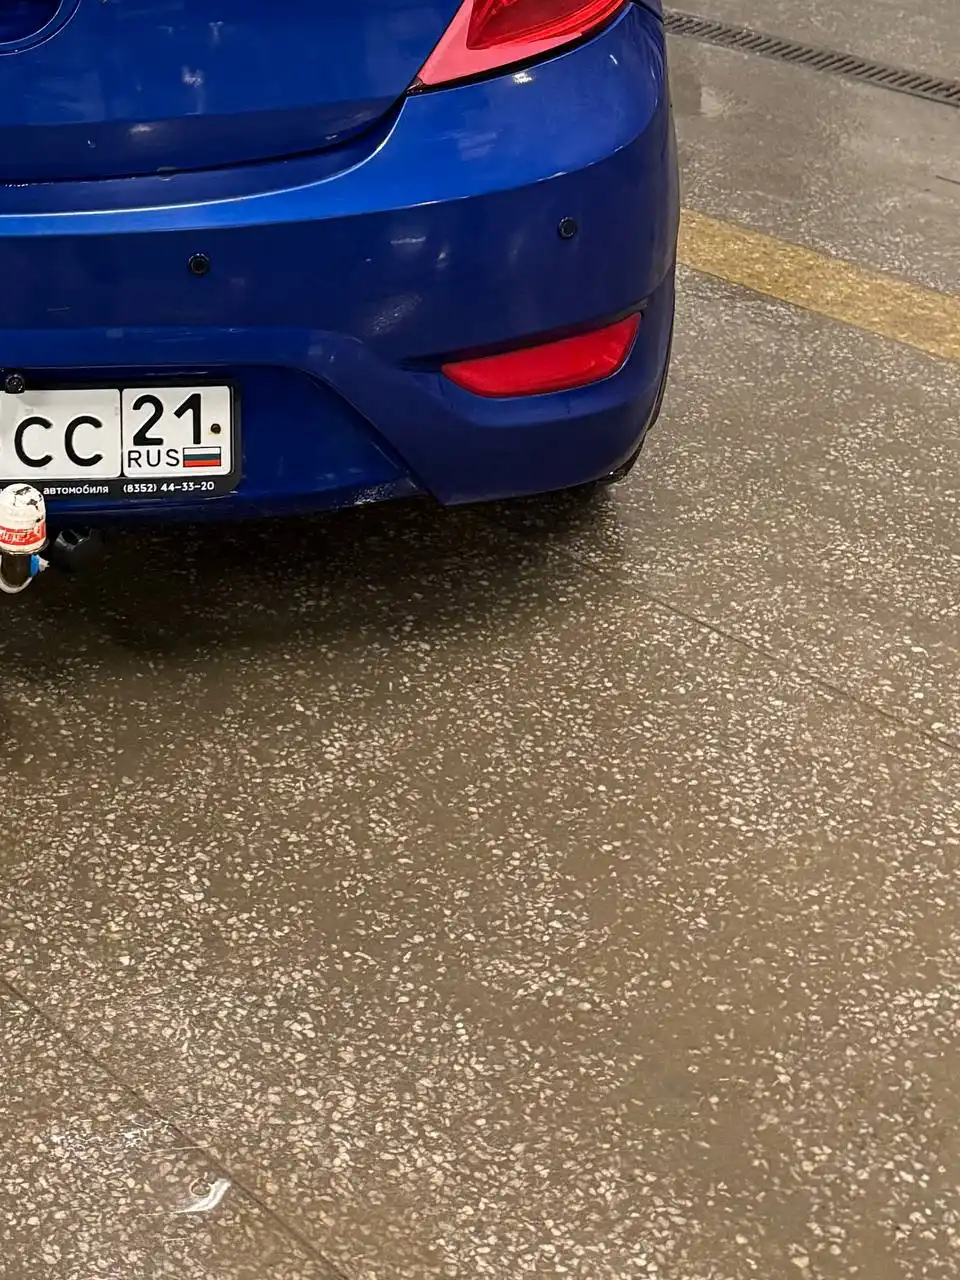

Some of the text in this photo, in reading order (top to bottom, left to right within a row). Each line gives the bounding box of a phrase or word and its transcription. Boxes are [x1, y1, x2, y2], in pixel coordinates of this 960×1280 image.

[132, 393, 202, 447] 21
[128, 448, 180, 468] RUS
[43, 484, 109, 496] автомобиля
[123, 483, 157, 494] (8352)
